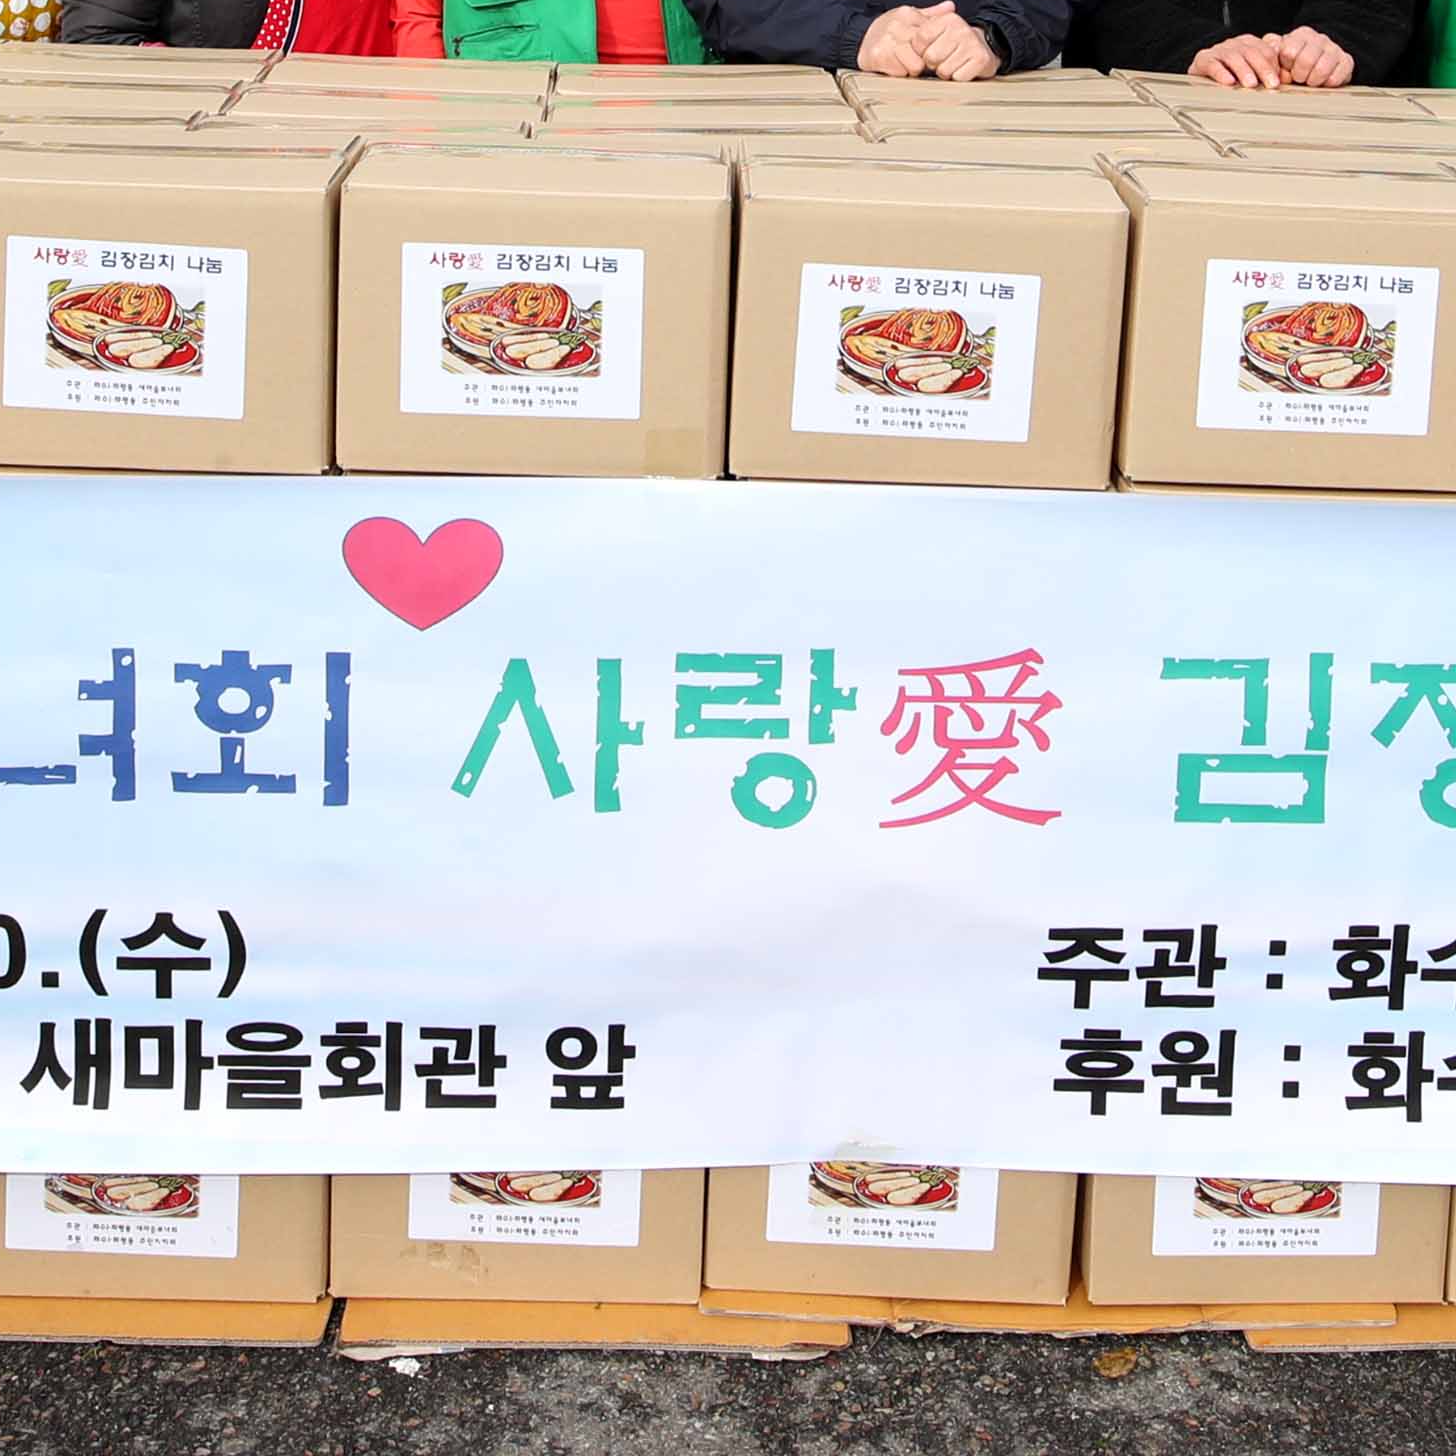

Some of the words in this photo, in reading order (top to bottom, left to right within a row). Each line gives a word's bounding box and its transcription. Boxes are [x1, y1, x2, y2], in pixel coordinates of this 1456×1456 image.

[102, 251, 174, 271] 김장김치
[188, 256, 222, 274] 나눔
[497, 254, 569, 271] 김장김치
[583, 256, 617, 272] 나눔
[895, 278, 967, 296] 김장김치
[980, 283, 1014, 299] 나눔
[1298, 273, 1367, 291] 김장김치
[1380, 277, 1413, 293] 나눔
[1038, 925, 1226, 1009] 주관
[20, 1018, 507, 1111] 새마을회관
[546, 1024, 636, 1110] 앞
[1053, 1029, 1236, 1116] 후원
